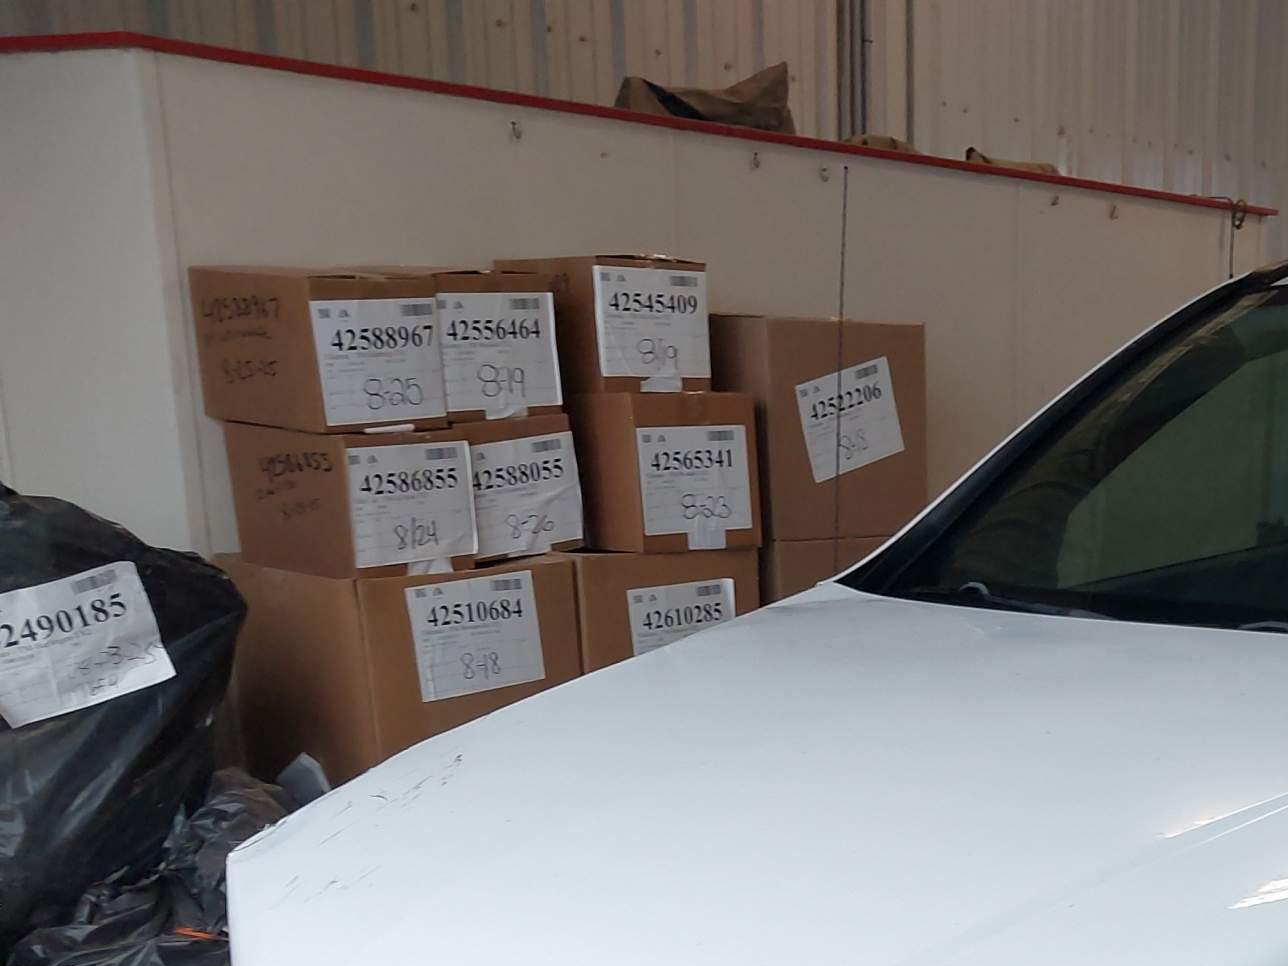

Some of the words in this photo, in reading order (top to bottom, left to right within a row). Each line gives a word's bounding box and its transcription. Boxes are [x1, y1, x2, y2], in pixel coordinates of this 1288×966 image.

[609, 292, 698, 314] 42545409
[331, 325, 433, 351] 42588967
[447, 318, 542, 341] 42556464
[810, 382, 882, 421] 42522206
[651, 449, 733, 471] 42565341
[360, 467, 458, 495] 42586855
[473, 458, 565, 491] 42588055
[0, 592, 128, 648] 2490185
[427, 598, 523, 627] 42510684
[643, 602, 723, 630] 42610285
